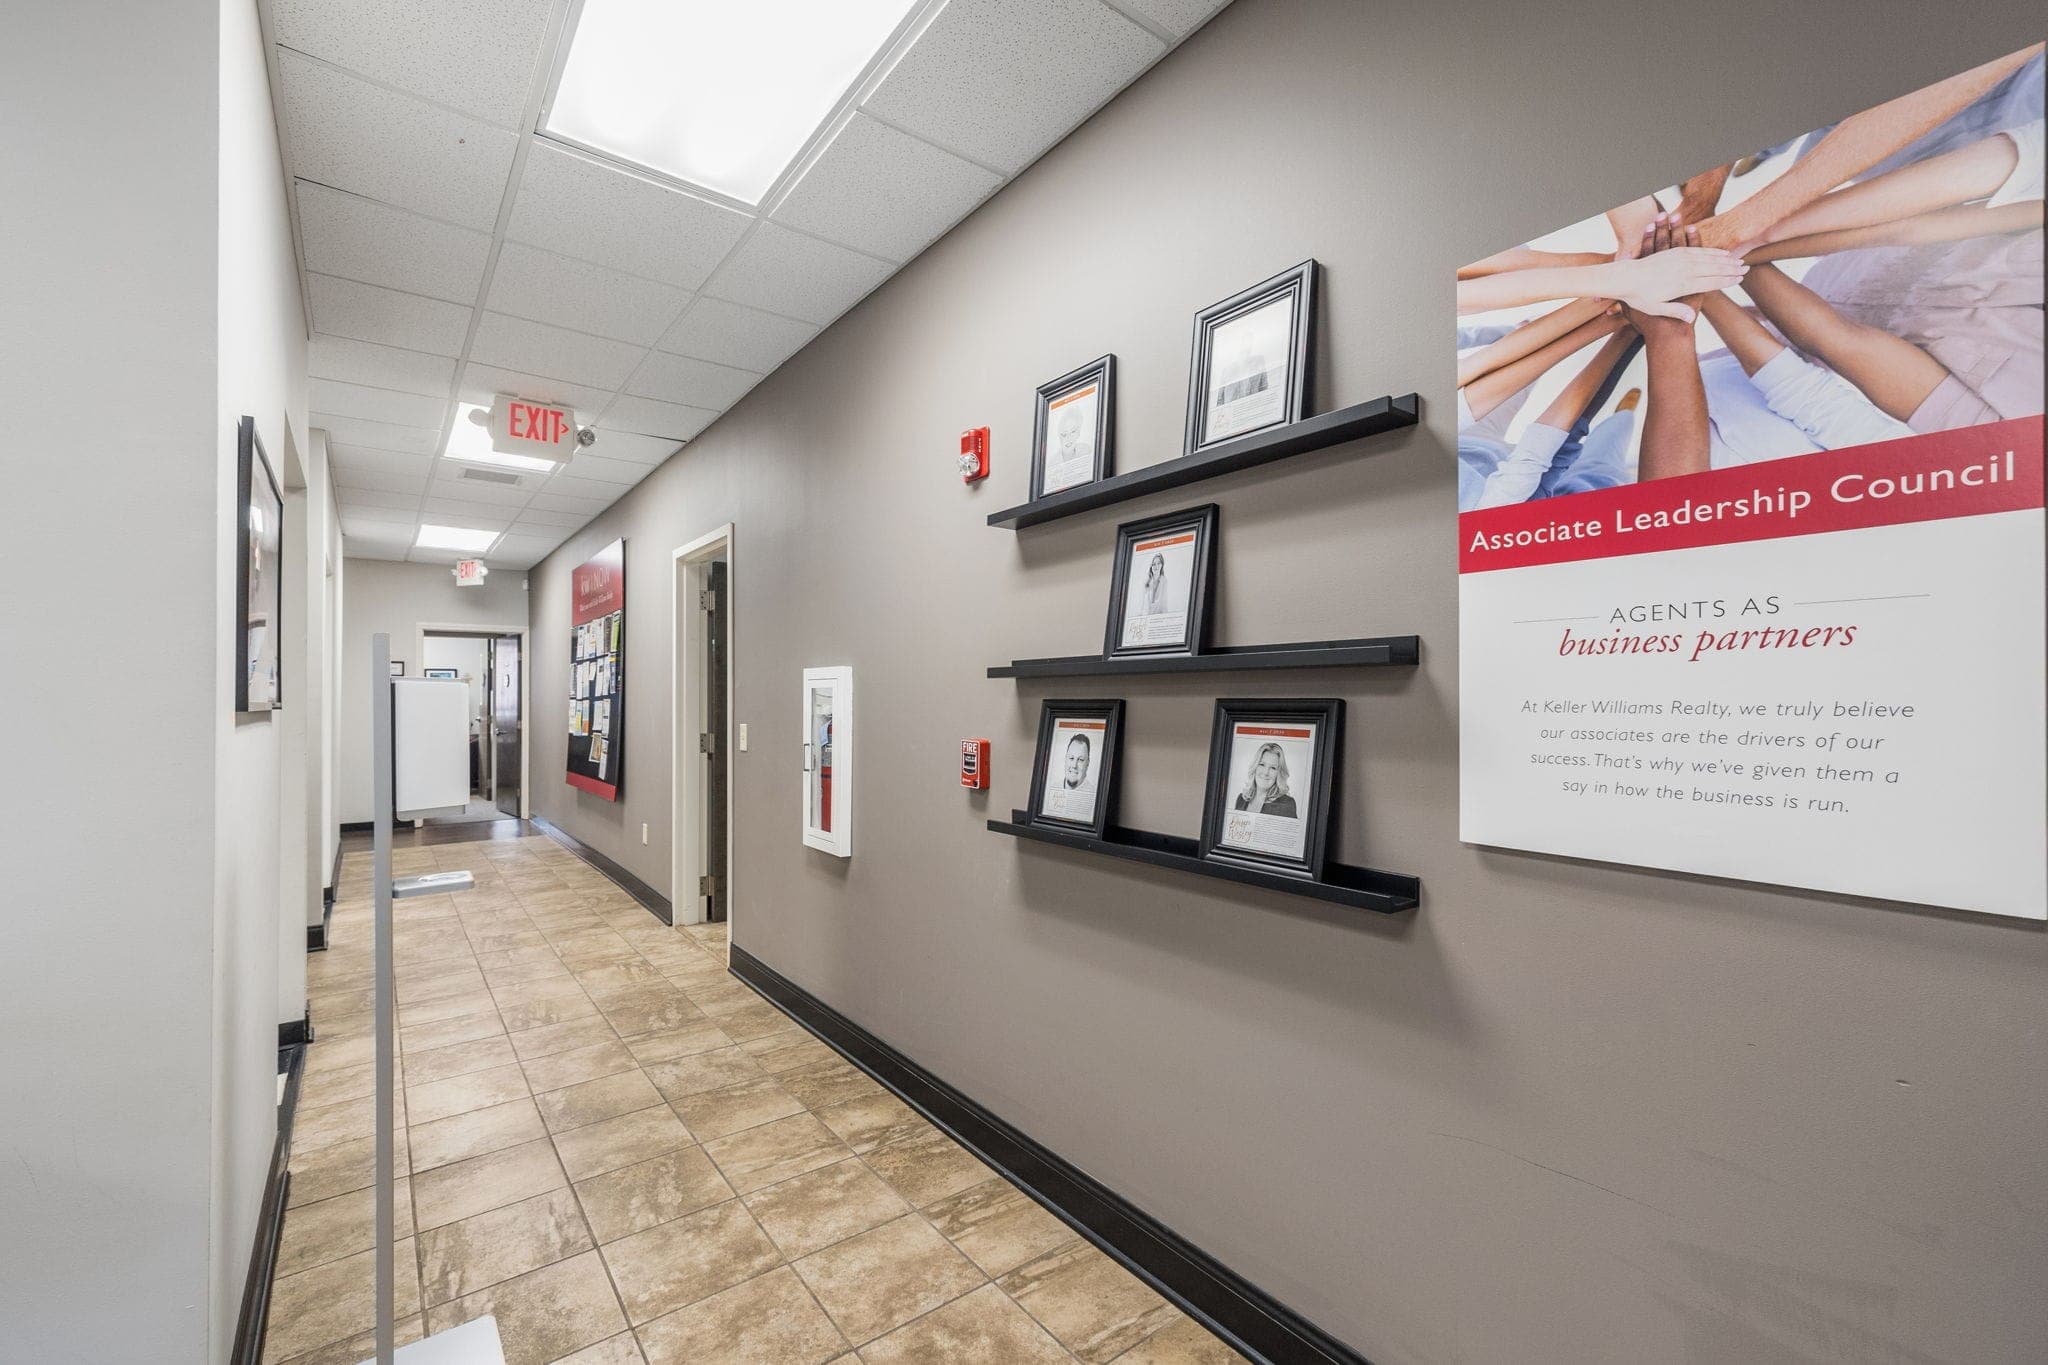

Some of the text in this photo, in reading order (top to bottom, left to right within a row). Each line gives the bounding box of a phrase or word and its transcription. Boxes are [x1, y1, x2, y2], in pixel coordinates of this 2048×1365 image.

[509, 402, 564, 443] EXIT
[1470, 451, 2015, 552] Associate Leadership Council
[460, 561, 475, 578] EXIT
[1610, 595, 1779, 624] AGENTS AS
[1559, 625, 1857, 662] business partners
[1521, 700, 1914, 720] At Keller Williams Realty, we truly believe
[962, 742, 978, 753] FIRE
[1541, 730, 1885, 752] our associates are the drivers of our
[1531, 753, 1898, 783] success. That's why we've given them a
[1563, 780, 1848, 812] say in how the business is run.
